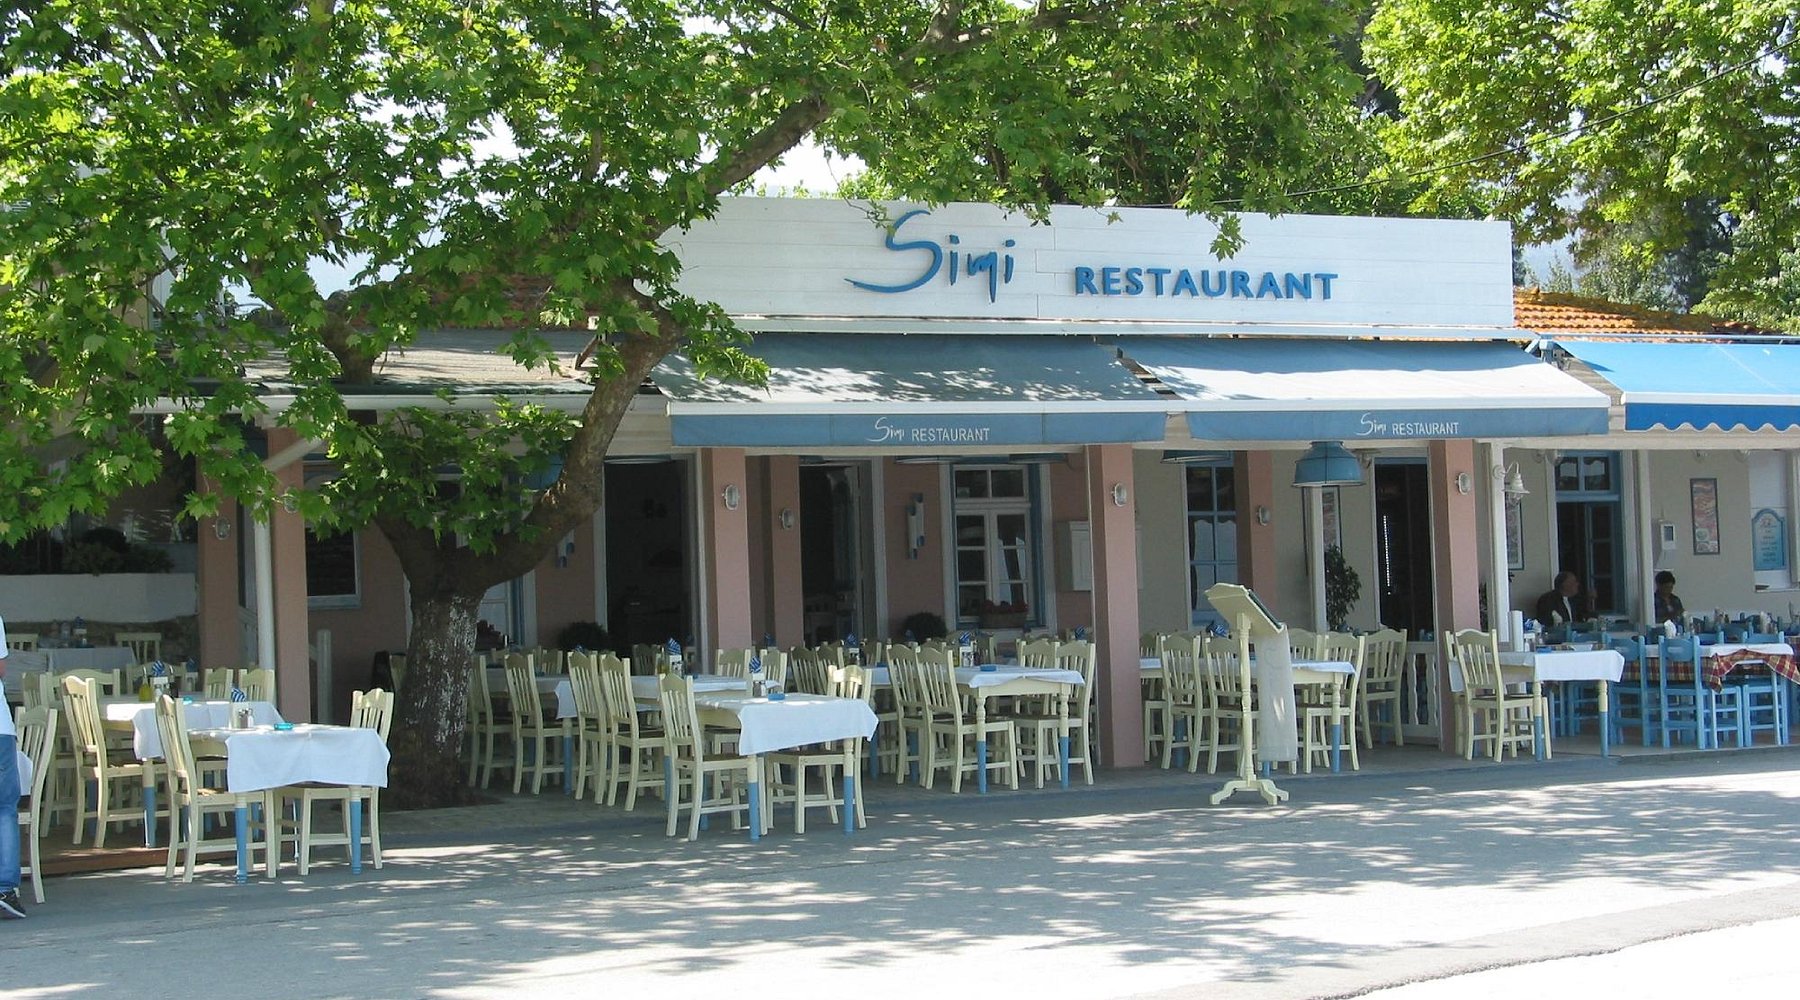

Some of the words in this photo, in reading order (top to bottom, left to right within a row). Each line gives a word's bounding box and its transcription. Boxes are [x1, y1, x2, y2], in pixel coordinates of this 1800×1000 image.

[844, 209, 1015, 303] Simi
[1075, 265, 1338, 299] RESTAURANT
[865, 416, 905, 442] Simi
[911, 427, 990, 442] RESTAURANT
[1355, 412, 1387, 436] Simi
[1392, 422, 1459, 436] RESTAURANT
